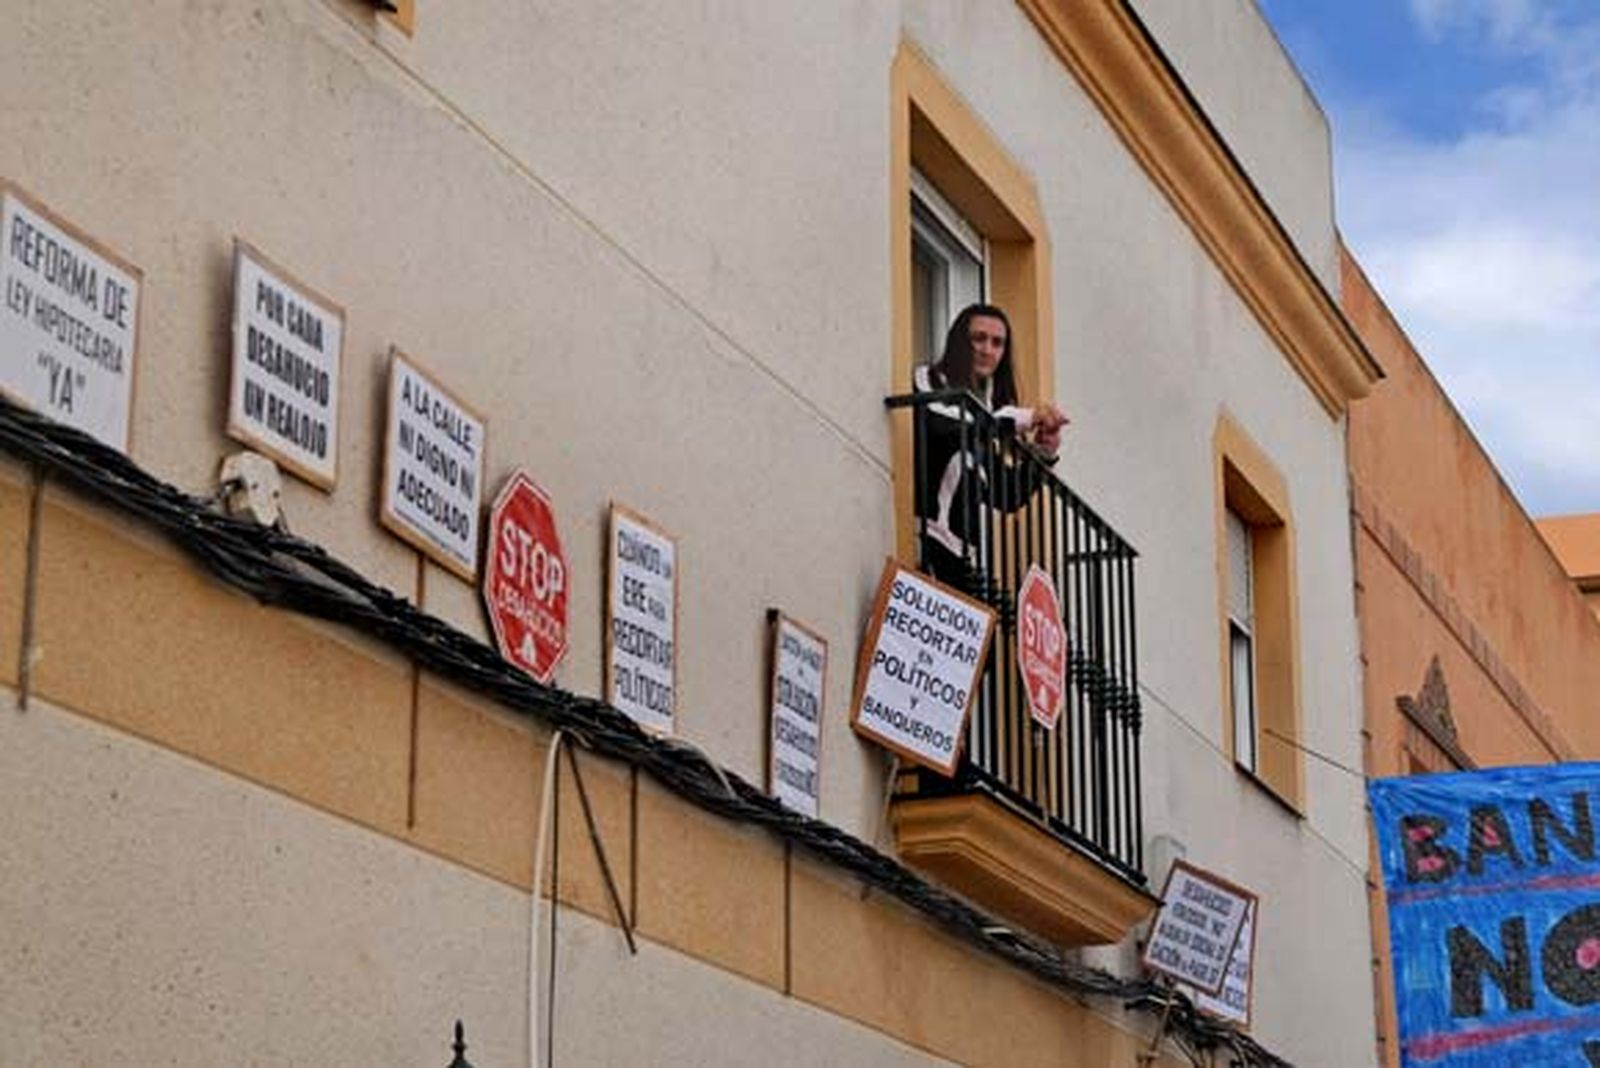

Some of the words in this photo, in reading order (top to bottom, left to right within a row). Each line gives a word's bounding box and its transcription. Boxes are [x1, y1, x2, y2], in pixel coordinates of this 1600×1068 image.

[9, 214, 98, 313] REFORMA
[103, 276, 128, 329] DE
[6, 275, 30, 318] LEY
[35, 292, 124, 374] HIPOTECARIA
[256, 278, 284, 327] POR
[288, 299, 324, 353] CADA
[248, 324, 330, 407] DESAHUCIO
[402, 374, 412, 405] A
[415, 388, 431, 424] LA
[244, 379, 266, 424] UN
[266, 387, 328, 460] REALOJO
[399, 418, 415, 454] NI
[415, 434, 459, 489] DIGNO
[397, 467, 470, 542] ADECUADO
[500, 518, 563, 605] STOP
[622, 574, 647, 615] ERE
[885, 605, 979, 667] RECORTAR
[1023, 601, 1061, 660] STOP
[614, 664, 672, 716] POLÍTICOS
[873, 648, 968, 712] POLÍTICOS
[909, 694, 920, 711] Y
[863, 694, 954, 753] BANQUEROS
[1402, 793, 1595, 884] BAN
[1447, 903, 1600, 1017] NO
